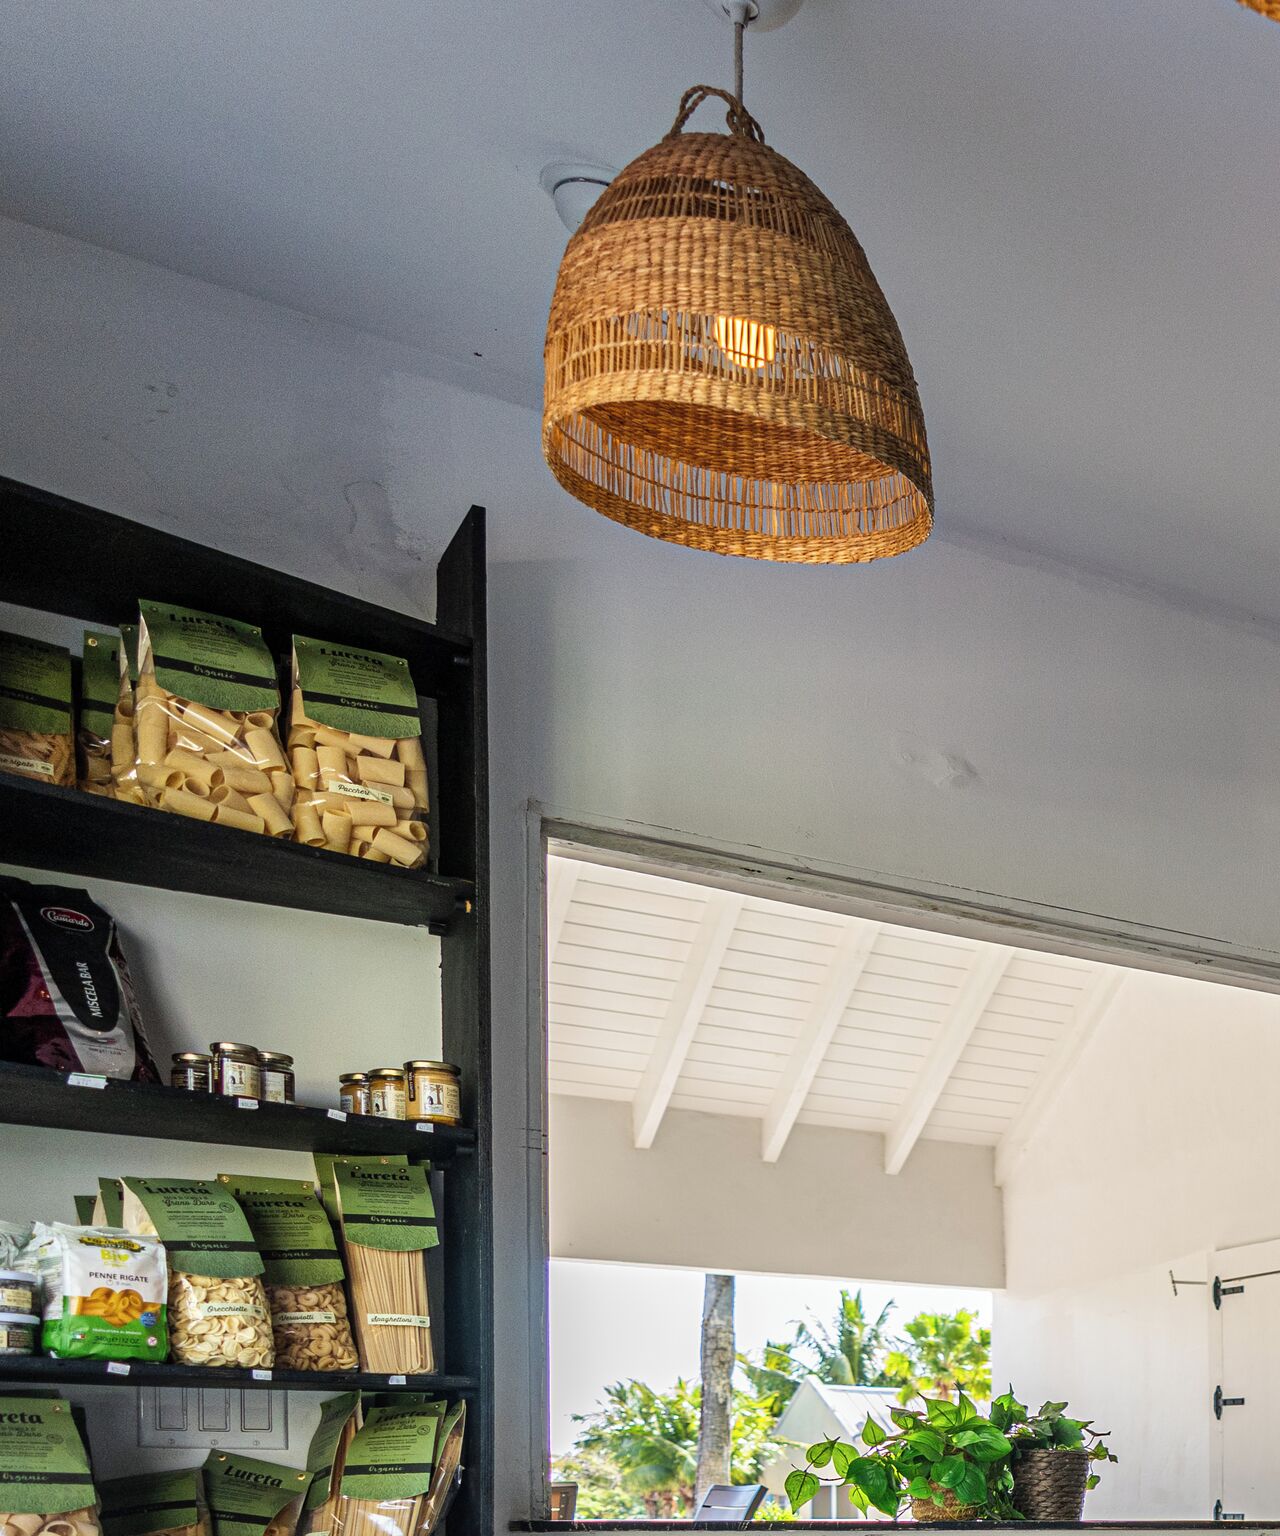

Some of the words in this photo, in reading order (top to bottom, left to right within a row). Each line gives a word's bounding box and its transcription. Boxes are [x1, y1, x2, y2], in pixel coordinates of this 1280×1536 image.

[76, 961, 91, 978] BAR
[86, 979, 103, 1018] MISCELA
[350, 1171, 410, 1181] Lureta
[144, 1185, 212, 1195] Lureta
[190, 1242, 230, 1250] Organic
[89, 1271, 117, 1280] PENNE
[120, 1275, 148, 1283] RIGATE
[2, 1472, 48, 1482] Organic
[224, 1465, 283, 1488] Lureta
